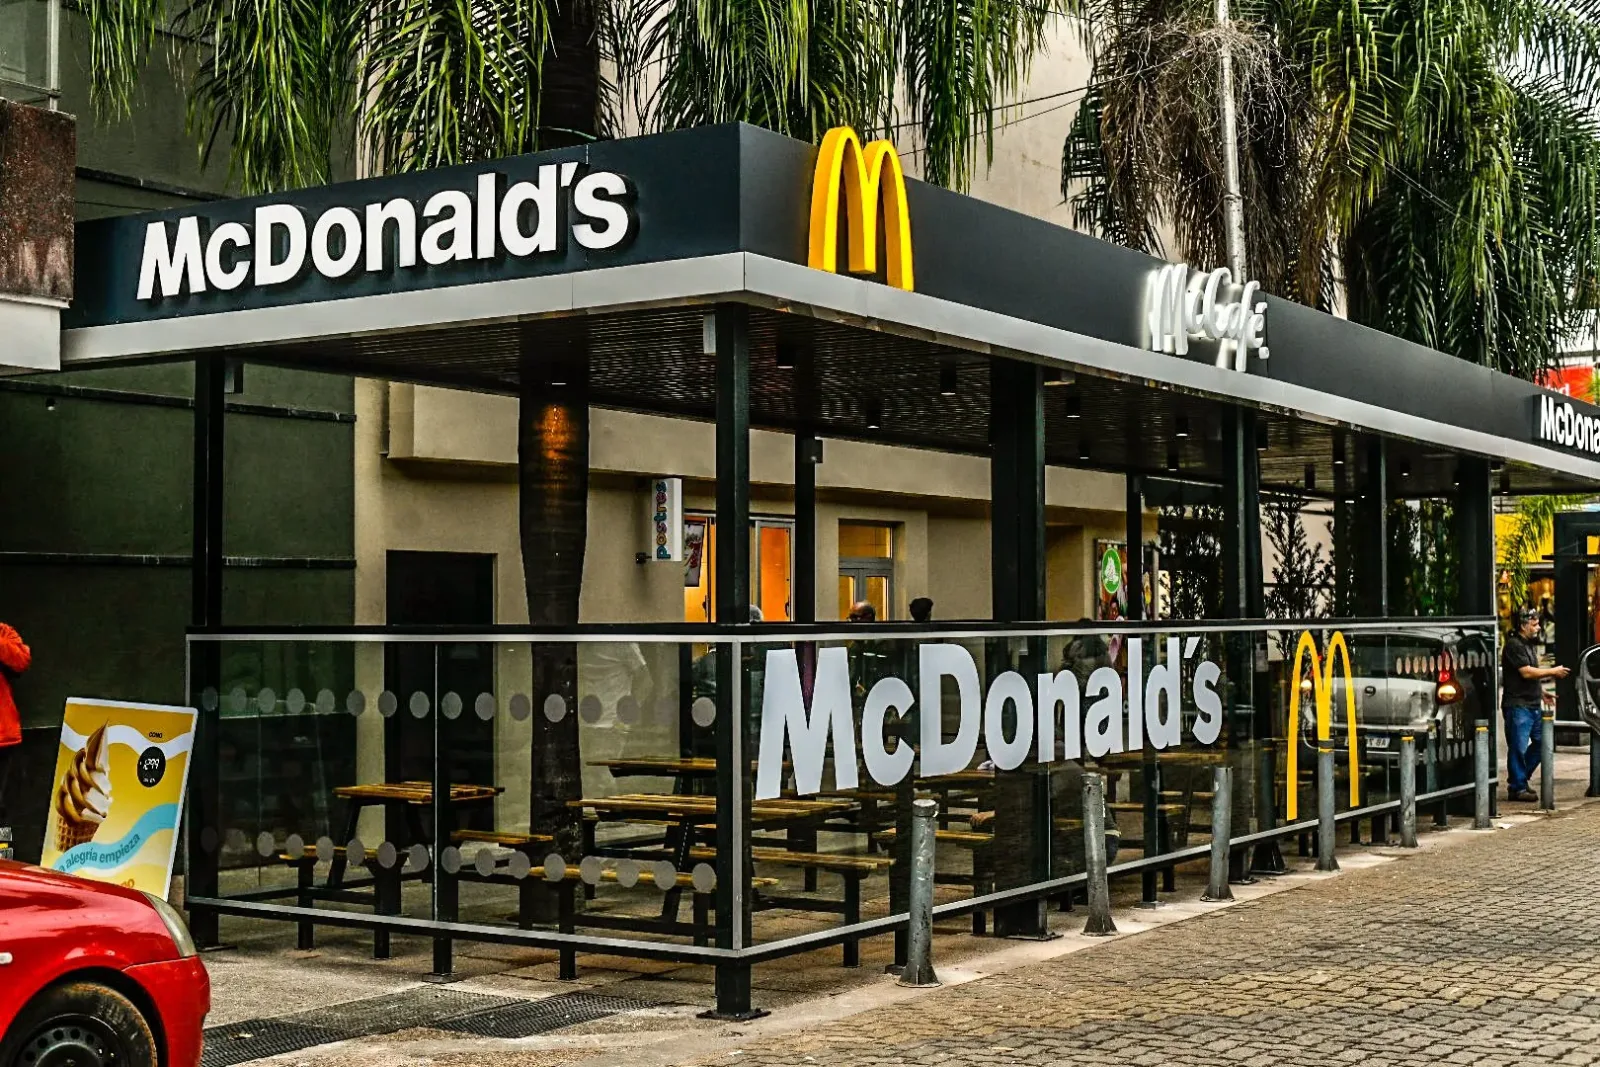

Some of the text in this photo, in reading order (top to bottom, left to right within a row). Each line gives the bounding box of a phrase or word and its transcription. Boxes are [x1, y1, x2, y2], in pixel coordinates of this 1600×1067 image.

[136, 161, 629, 300] McDonald's
[654, 481, 671, 559] postres
[755, 637, 1222, 800] McDonald's
[66, 847, 98, 868] alegría
[99, 833, 140, 864] empieza
